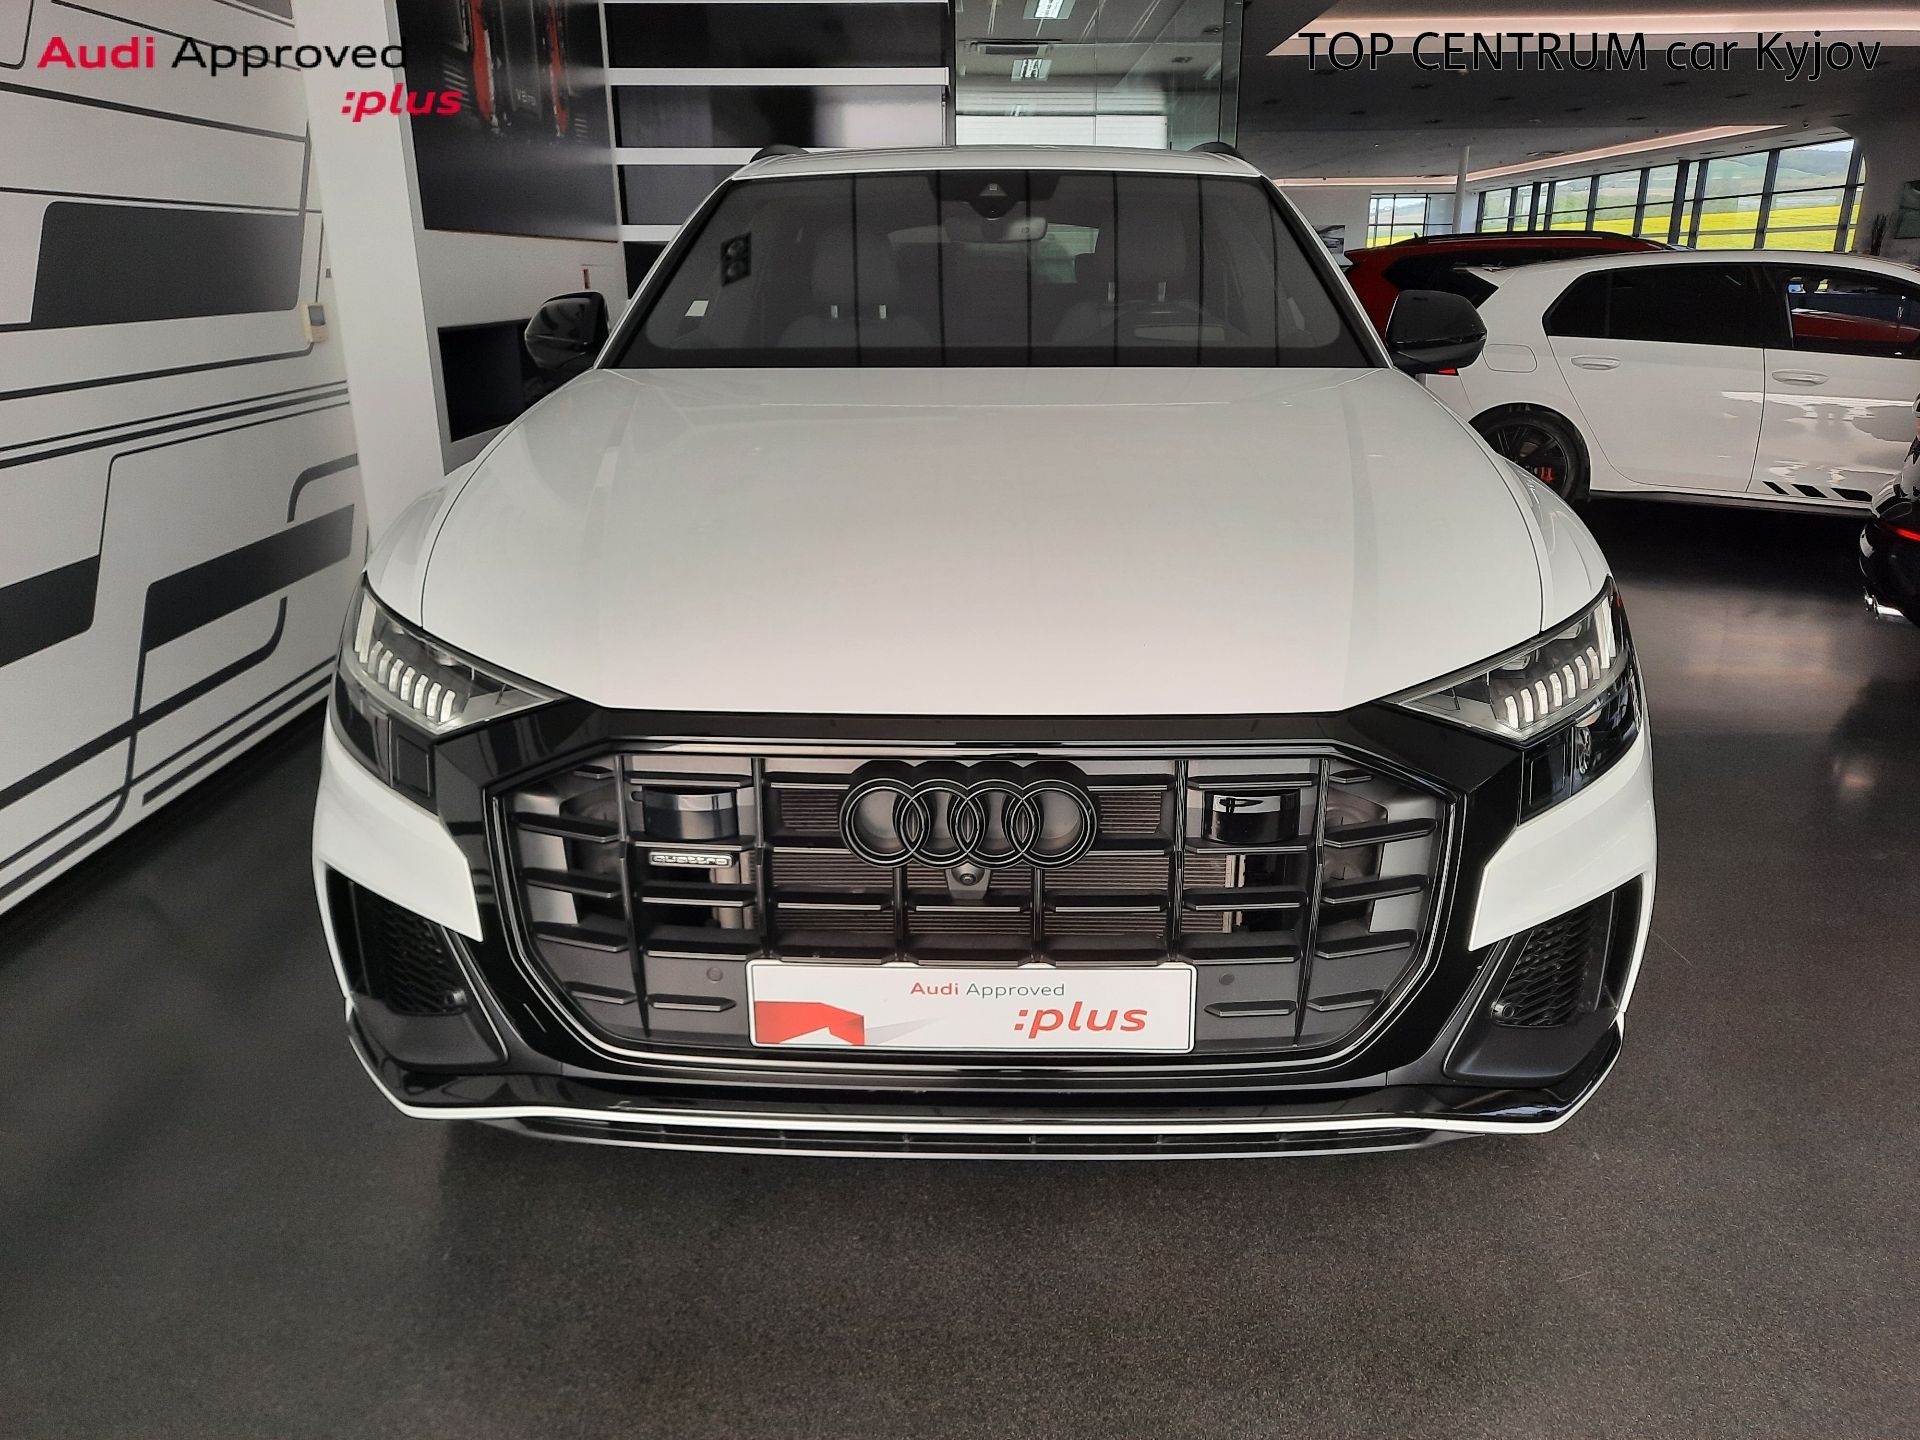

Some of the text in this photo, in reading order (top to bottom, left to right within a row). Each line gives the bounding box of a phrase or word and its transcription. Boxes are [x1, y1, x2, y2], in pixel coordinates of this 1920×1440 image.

[653, 854, 728, 867] quattro
[910, 982, 1065, 999] Audi Approved
[1014, 1001, 1148, 1039] :plus
